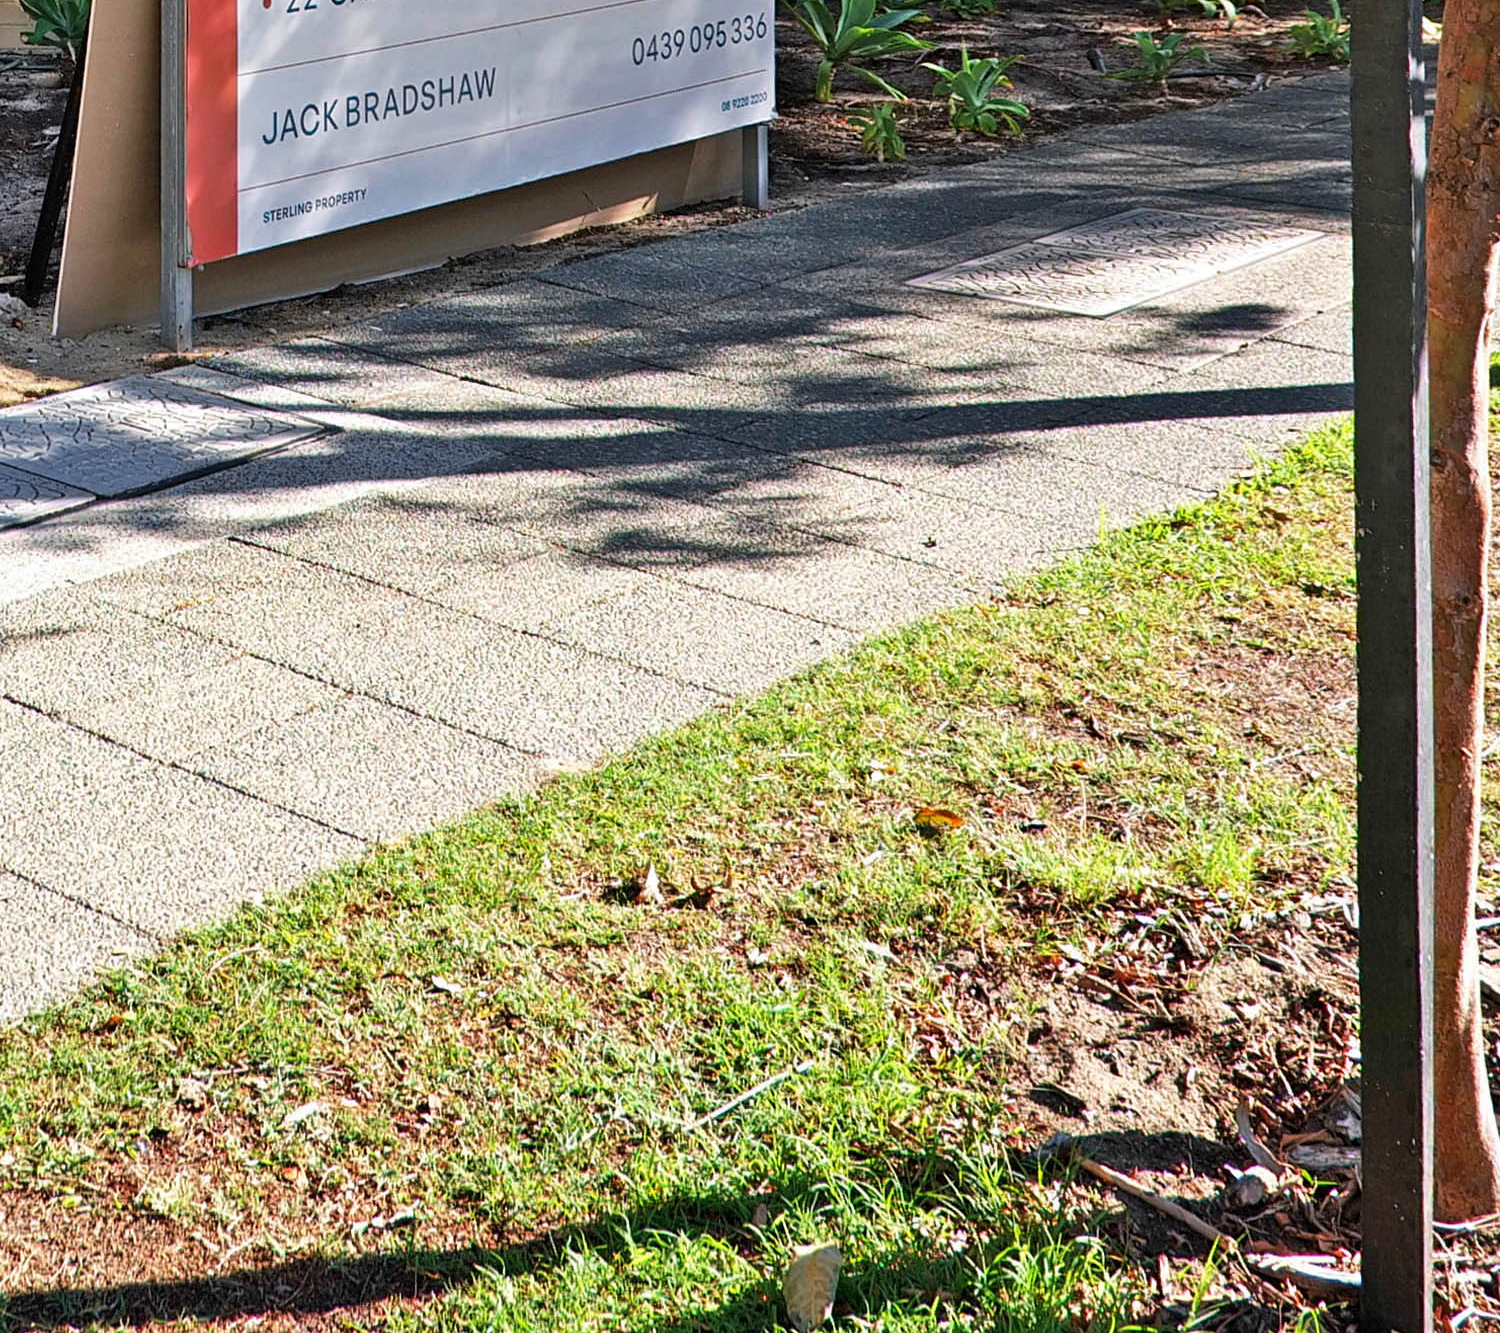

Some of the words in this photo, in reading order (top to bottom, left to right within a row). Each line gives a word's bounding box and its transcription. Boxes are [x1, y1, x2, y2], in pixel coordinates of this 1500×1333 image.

[632, 28, 686, 66] 0439
[689, 20, 727, 54] 095
[731, 12, 767, 45] 336
[262, 98, 339, 145] JACK
[346, 67, 497, 128] BRADSHAW
[263, 200, 313, 224] STERLING
[315, 188, 368, 212] PROPERTY
